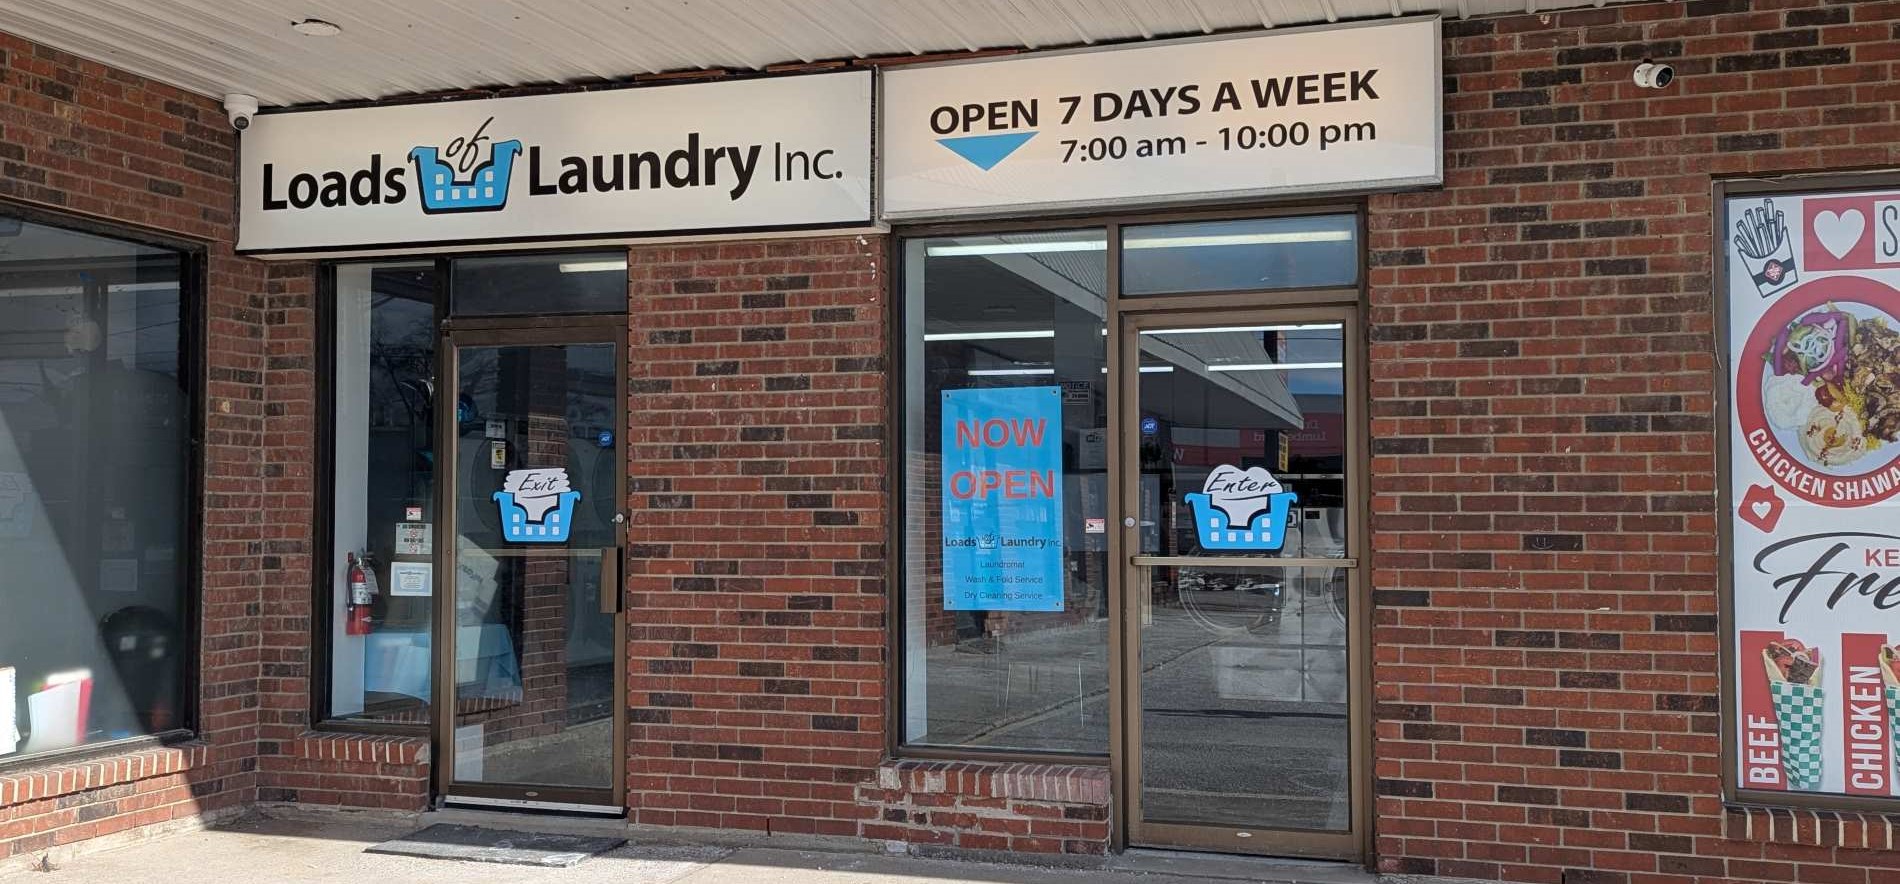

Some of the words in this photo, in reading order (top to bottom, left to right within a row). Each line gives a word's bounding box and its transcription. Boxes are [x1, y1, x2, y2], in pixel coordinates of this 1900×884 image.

[930, 98, 1039, 135] OPEN
[1059, 95, 1082, 125] 7
[1093, 84, 1201, 123] DAYS
[1211, 80, 1242, 113] A
[1251, 68, 1381, 109] WEEK
[1060, 135, 1127, 163] 7:00
[1136, 136, 1187, 159] am
[1218, 123, 1310, 152] 10:00
[1320, 121, 1378, 150] pm
[262, 154, 407, 211] Loads
[446, 116, 494, 172] of
[528, 132, 763, 201] Laundry
[774, 142, 843, 182] Inc.
[1882, 204, 1899, 257] S
[956, 418, 1047, 448] NOW
[1749, 428, 1826, 499] CHICKEN
[518, 473, 557, 492] Exit
[950, 470, 1054, 499] OPEN
[1207, 472, 1278, 493] Enter
[944, 536, 977, 547] Loads
[1000, 536, 1047, 549] Laundry
[964, 575, 987, 584] Wash
[988, 575, 995, 584] &
[996, 575, 1013, 584] Fold
[1014, 575, 1043, 584] Service
[980, 560, 1025, 569] Laundromat
[964, 591, 977, 601] Dry
[979, 591, 1013, 601] Cleaning
[1014, 591, 1043, 600] Service
[1850, 666, 1884, 790] CHICKEN
[1748, 714, 1779, 785] BEEF
